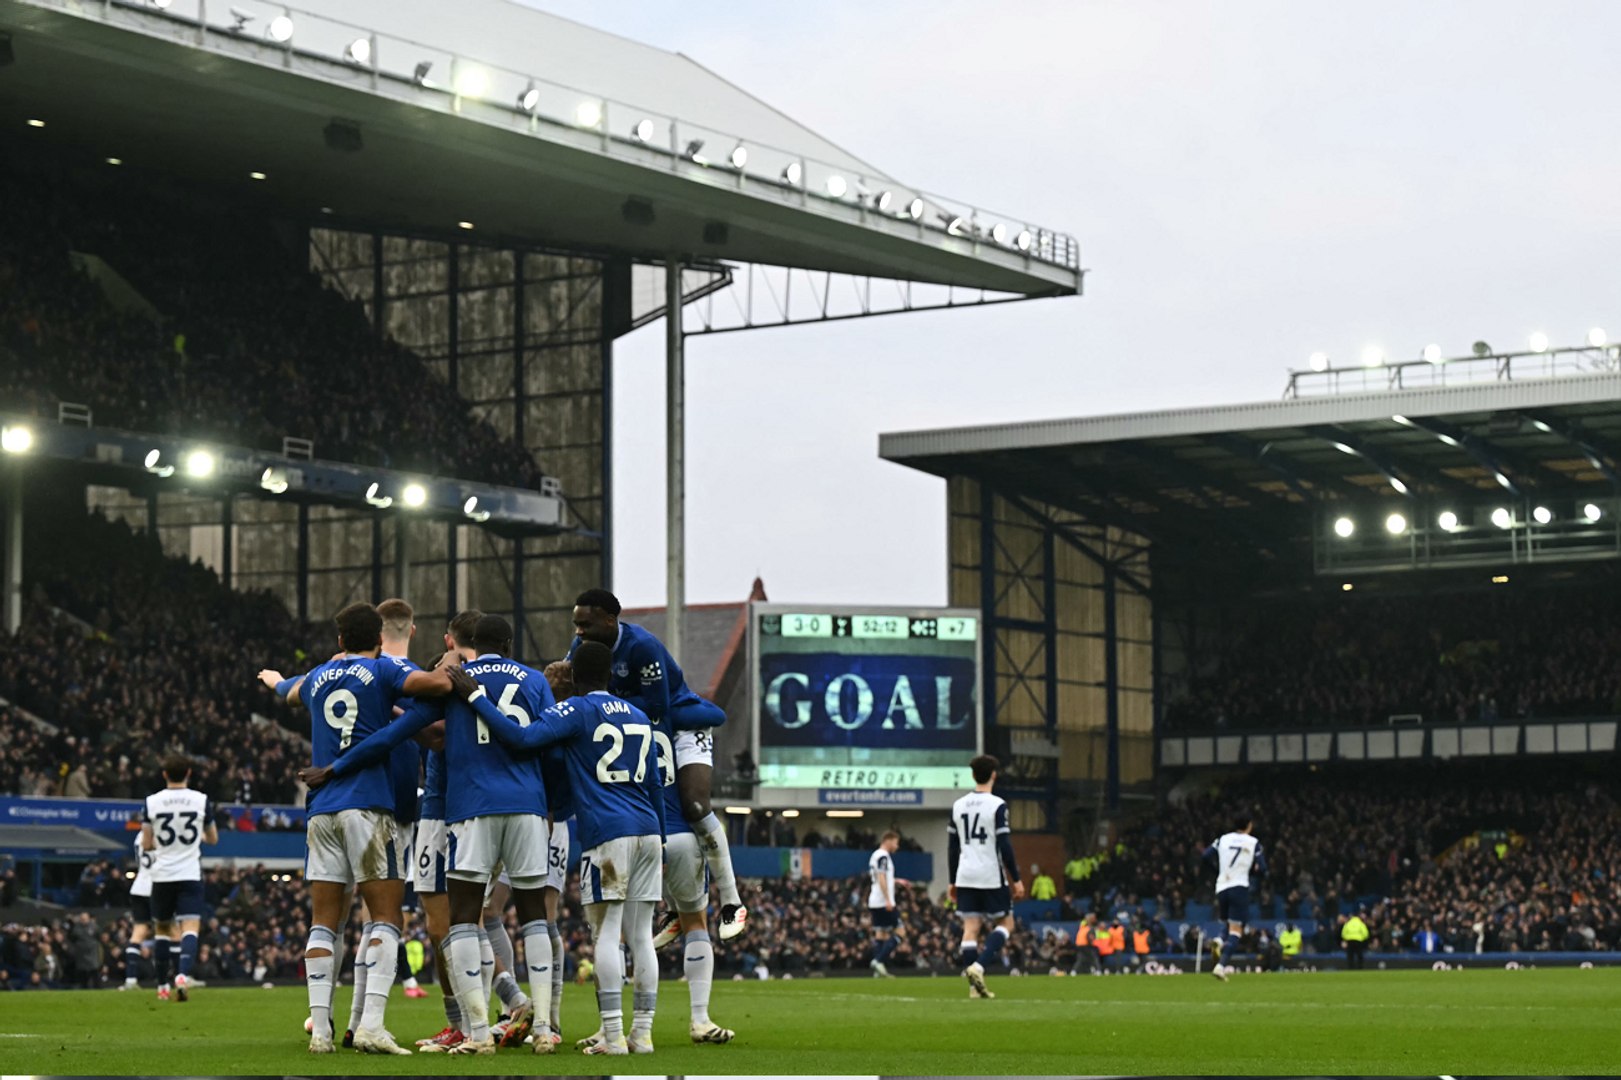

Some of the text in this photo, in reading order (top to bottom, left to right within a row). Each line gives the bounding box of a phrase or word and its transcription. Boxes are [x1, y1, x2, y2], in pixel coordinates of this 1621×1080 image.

[477, 683, 531, 744] 16
[602, 701, 631, 715] GANA
[765, 672, 969, 729] GOAL
[324, 689, 358, 750] 9
[593, 722, 651, 783] 27
[821, 770, 919, 786] RETRO DAY
[156, 811, 198, 847] 33
[961, 813, 988, 845] 14
[419, 845, 430, 869] 6
[550, 846, 566, 871] 32
[1229, 846, 1242, 868] 7
